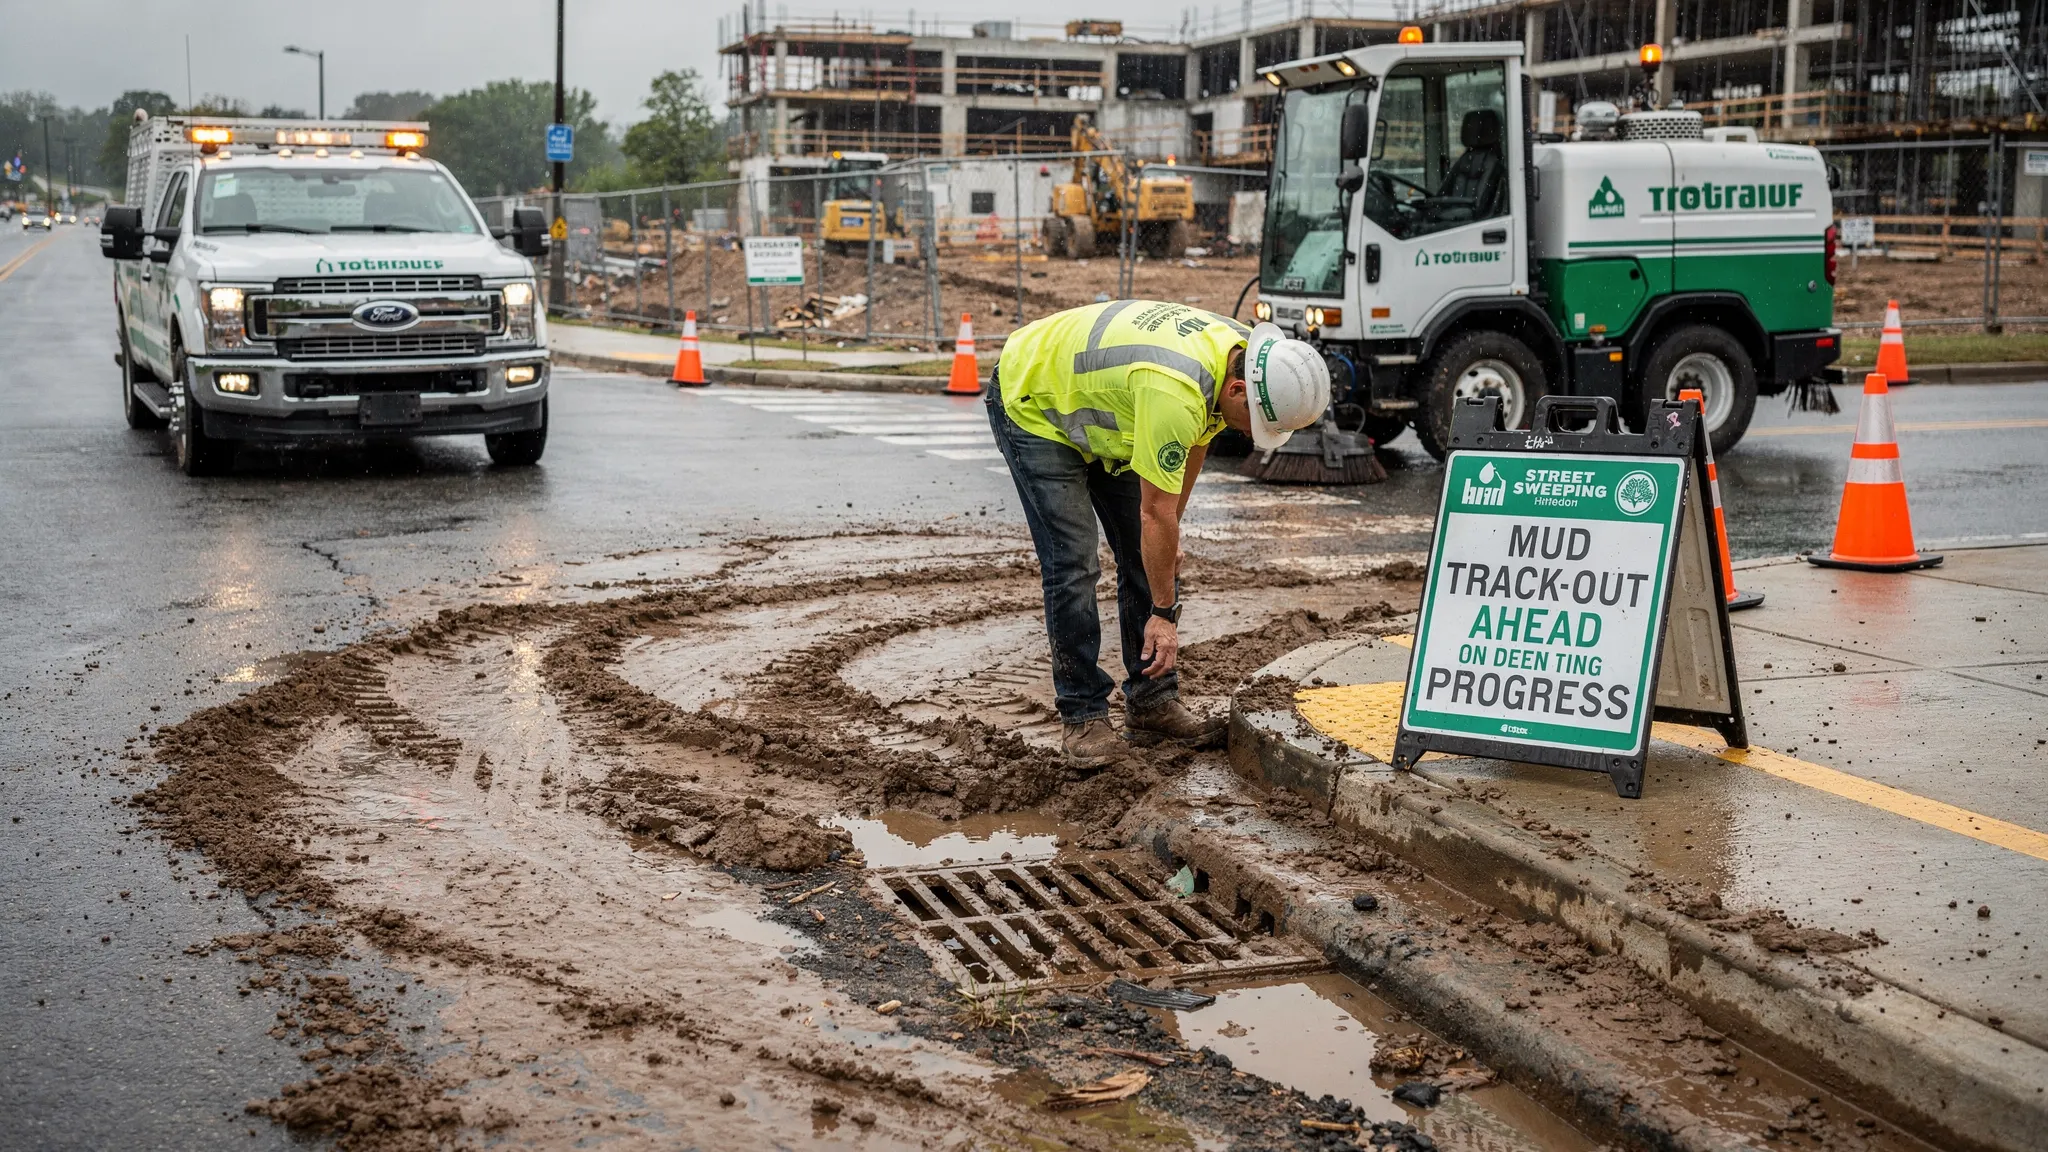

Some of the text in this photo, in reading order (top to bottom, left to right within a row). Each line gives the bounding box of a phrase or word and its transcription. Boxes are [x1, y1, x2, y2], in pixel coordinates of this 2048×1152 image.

[370, 306, 403, 322] Ford
[1513, 482, 1607, 498] SWEEPING
[1525, 469, 1595, 483] STREET
[1508, 525, 1591, 560] MUD
[1447, 562, 1649, 607] TRACK-OUT
[1468, 605, 1602, 648] AHEAD
[1459, 644, 1603, 676] ON DEEN TING
[1426, 667, 1630, 720] PROGRESS
